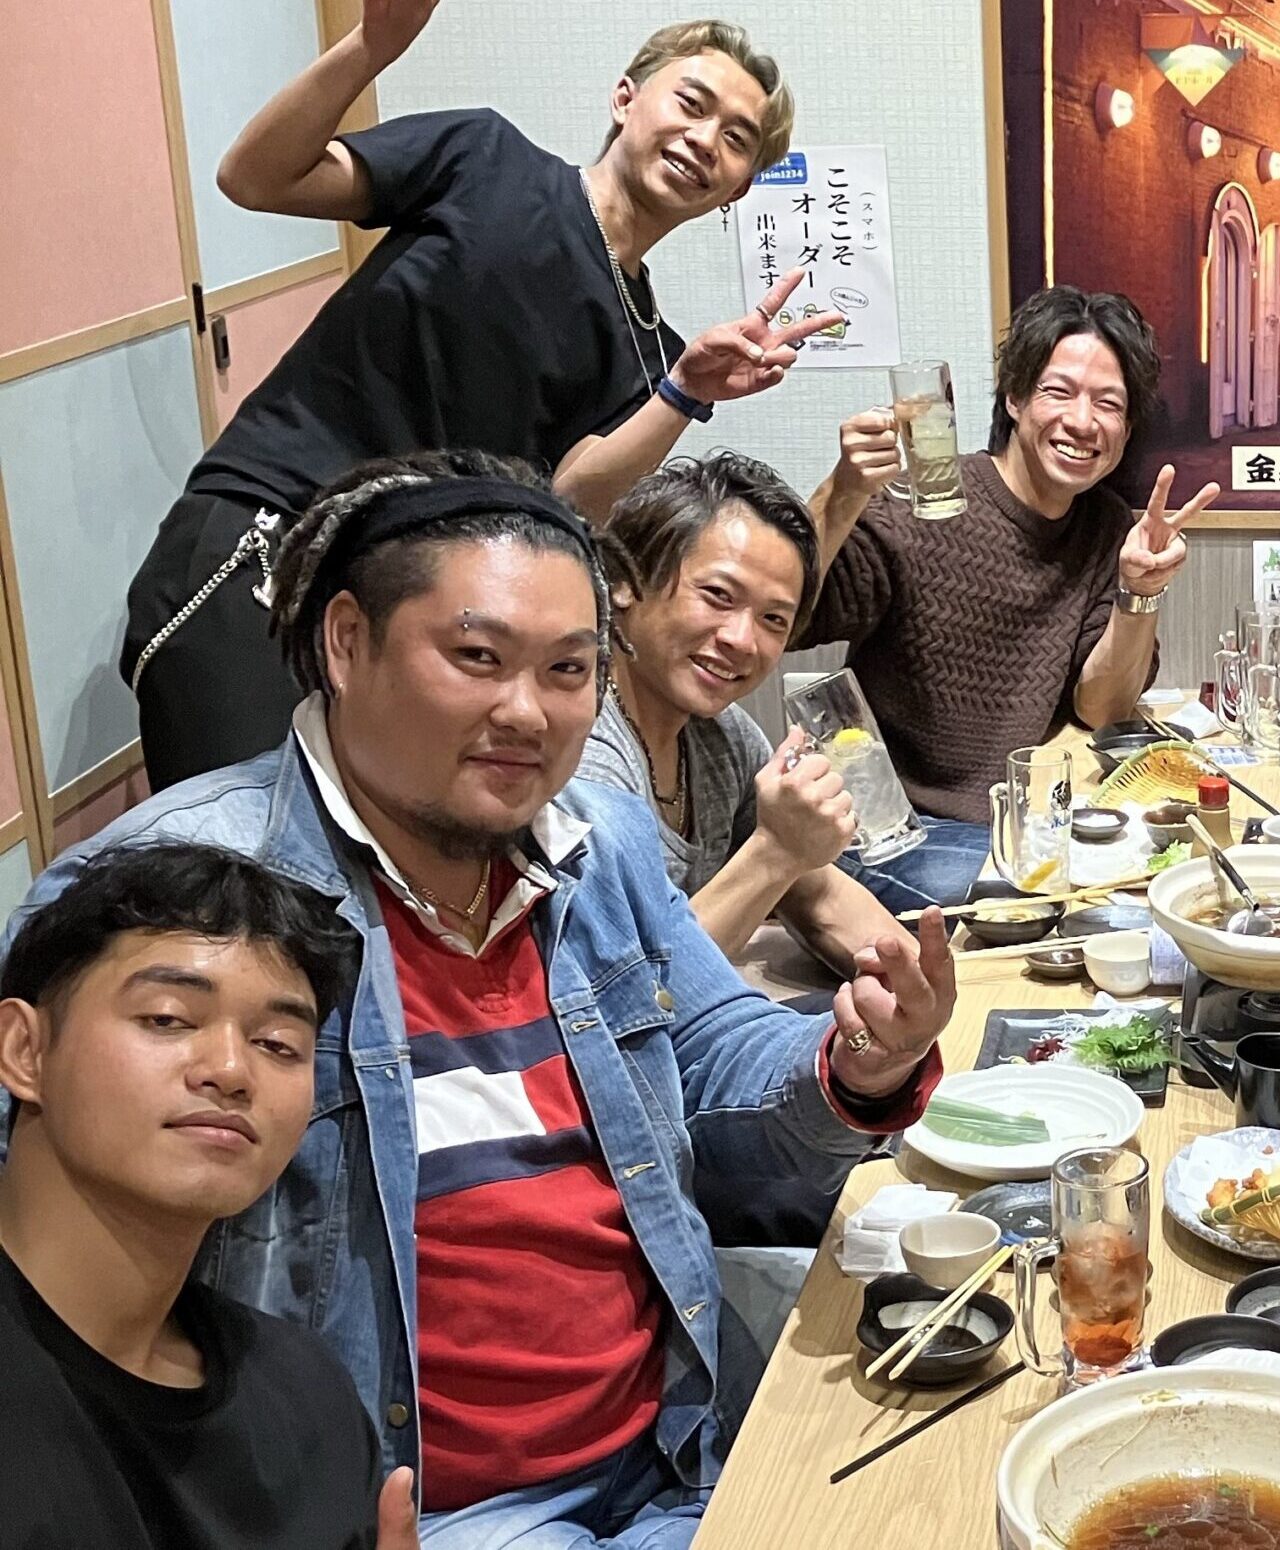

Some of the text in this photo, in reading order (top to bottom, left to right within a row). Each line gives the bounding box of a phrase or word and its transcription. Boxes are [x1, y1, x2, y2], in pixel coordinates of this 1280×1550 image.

[757, 213, 780, 288] 出来ます
[791, 193, 823, 288] オーダー
[827, 168, 855, 266] こそこそ
